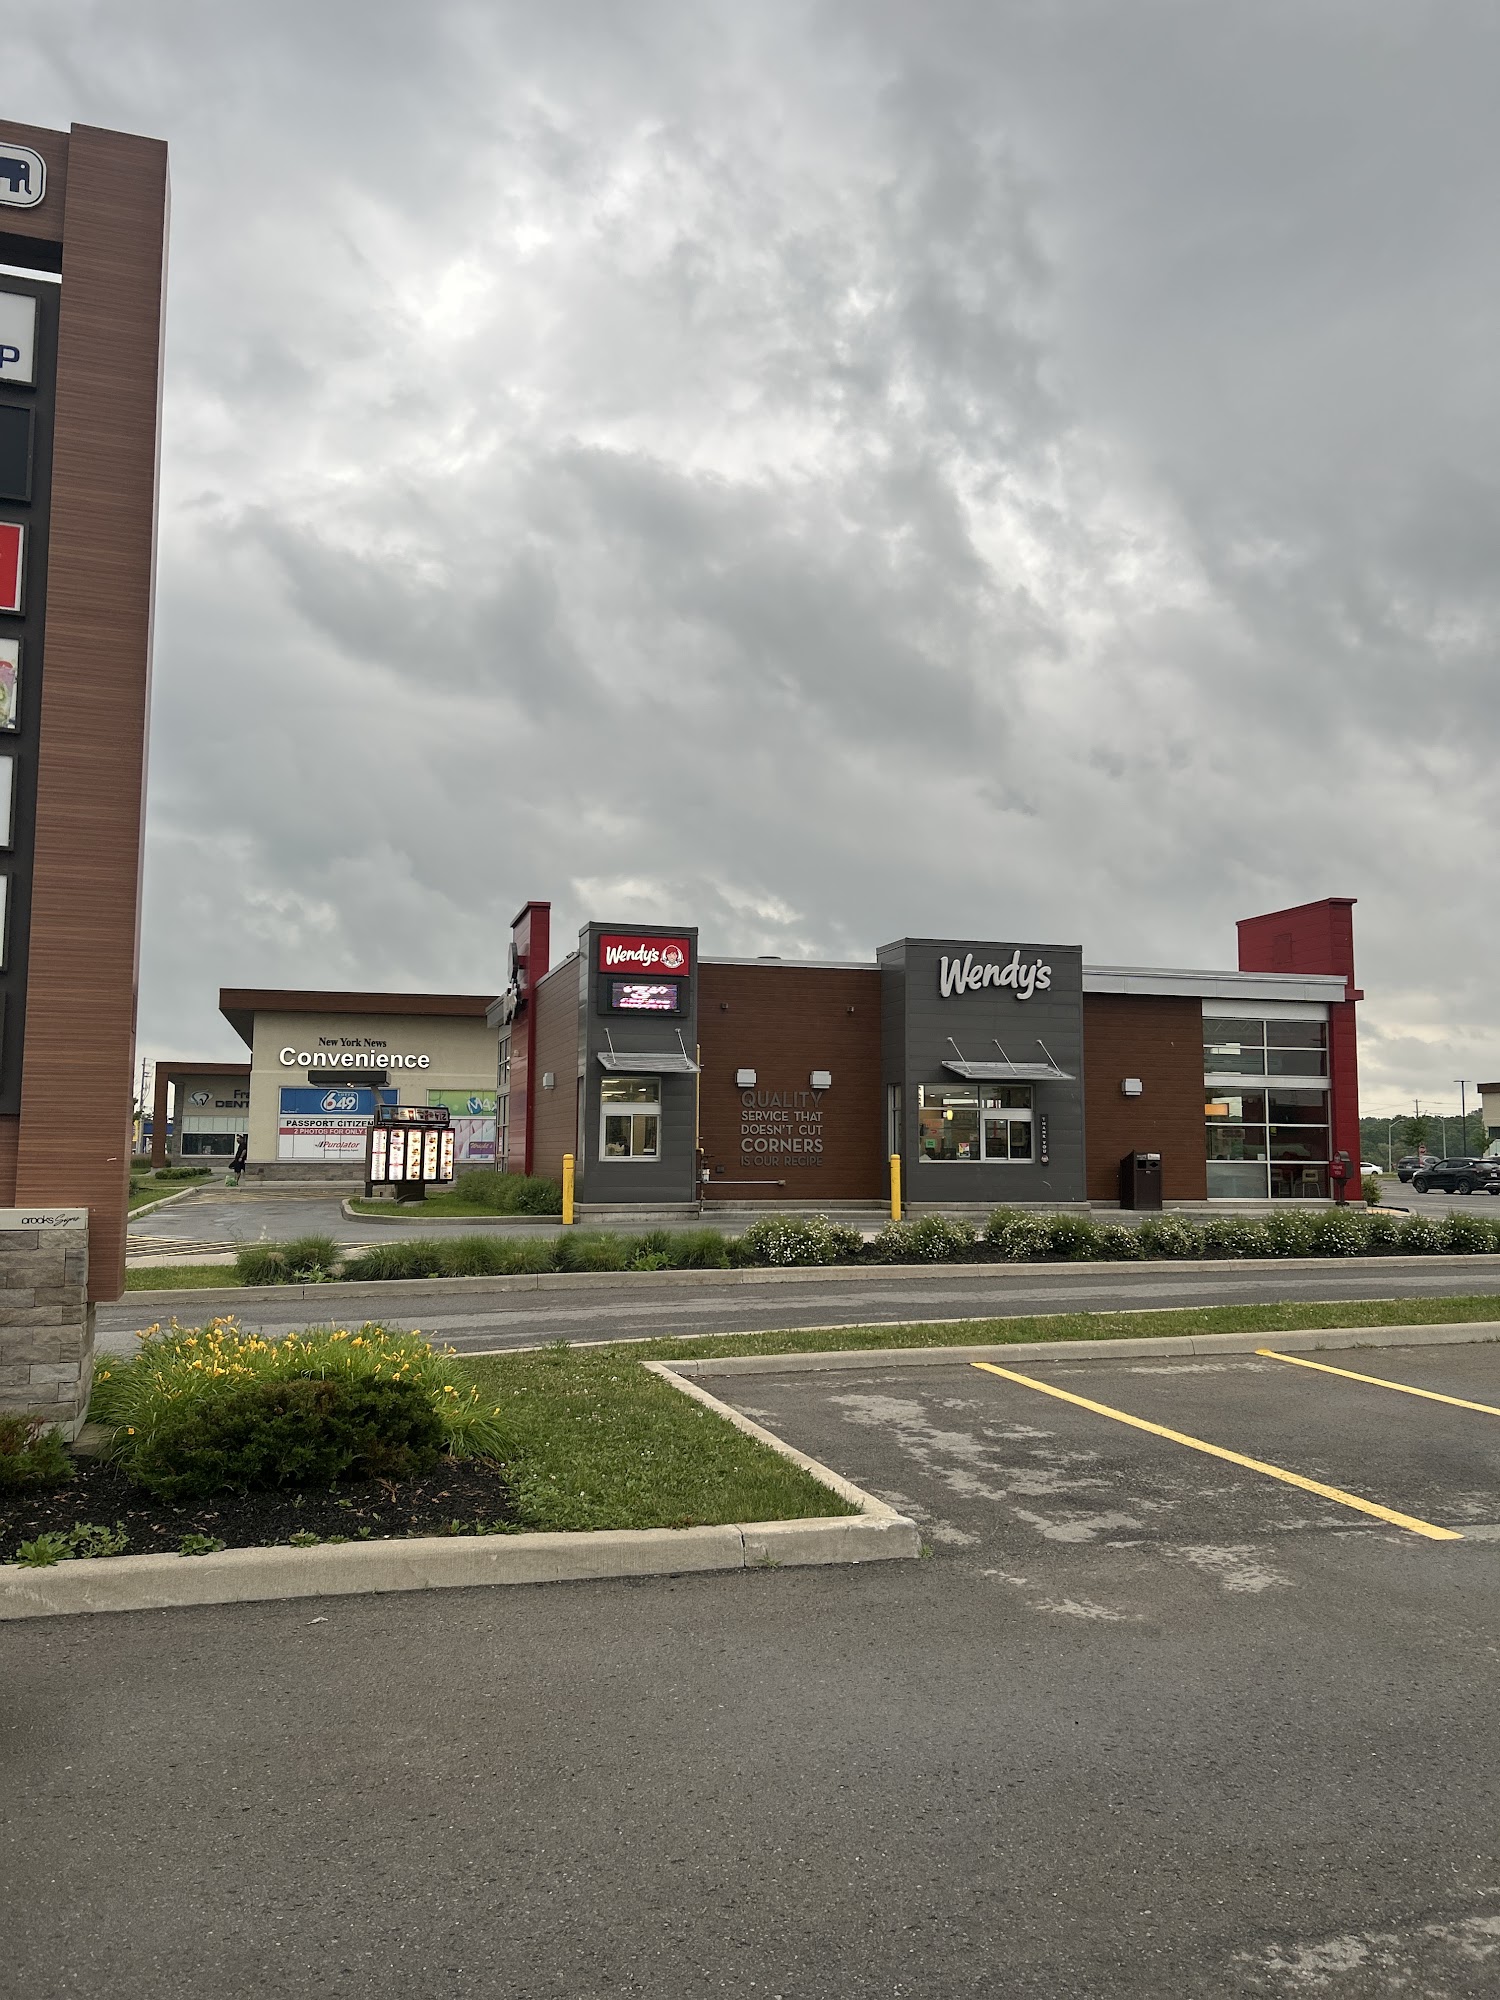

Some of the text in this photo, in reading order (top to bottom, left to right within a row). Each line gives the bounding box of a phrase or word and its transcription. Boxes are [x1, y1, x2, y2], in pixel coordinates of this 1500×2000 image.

[606, 943, 660, 967] Wendy's
[940, 950, 1052, 1000] Wendy's
[318, 1037, 387, 1047] New York News
[279, 1047, 430, 1068] Convenience
[741, 1090, 823, 1108] QUALITY
[741, 1110, 823, 1122] SERVICE THAT
[741, 1124, 823, 1136] DOESN'T CUT
[741, 1137, 824, 1153] CORNERS
[741, 1155, 823, 1167] IS OUR RECIPE
